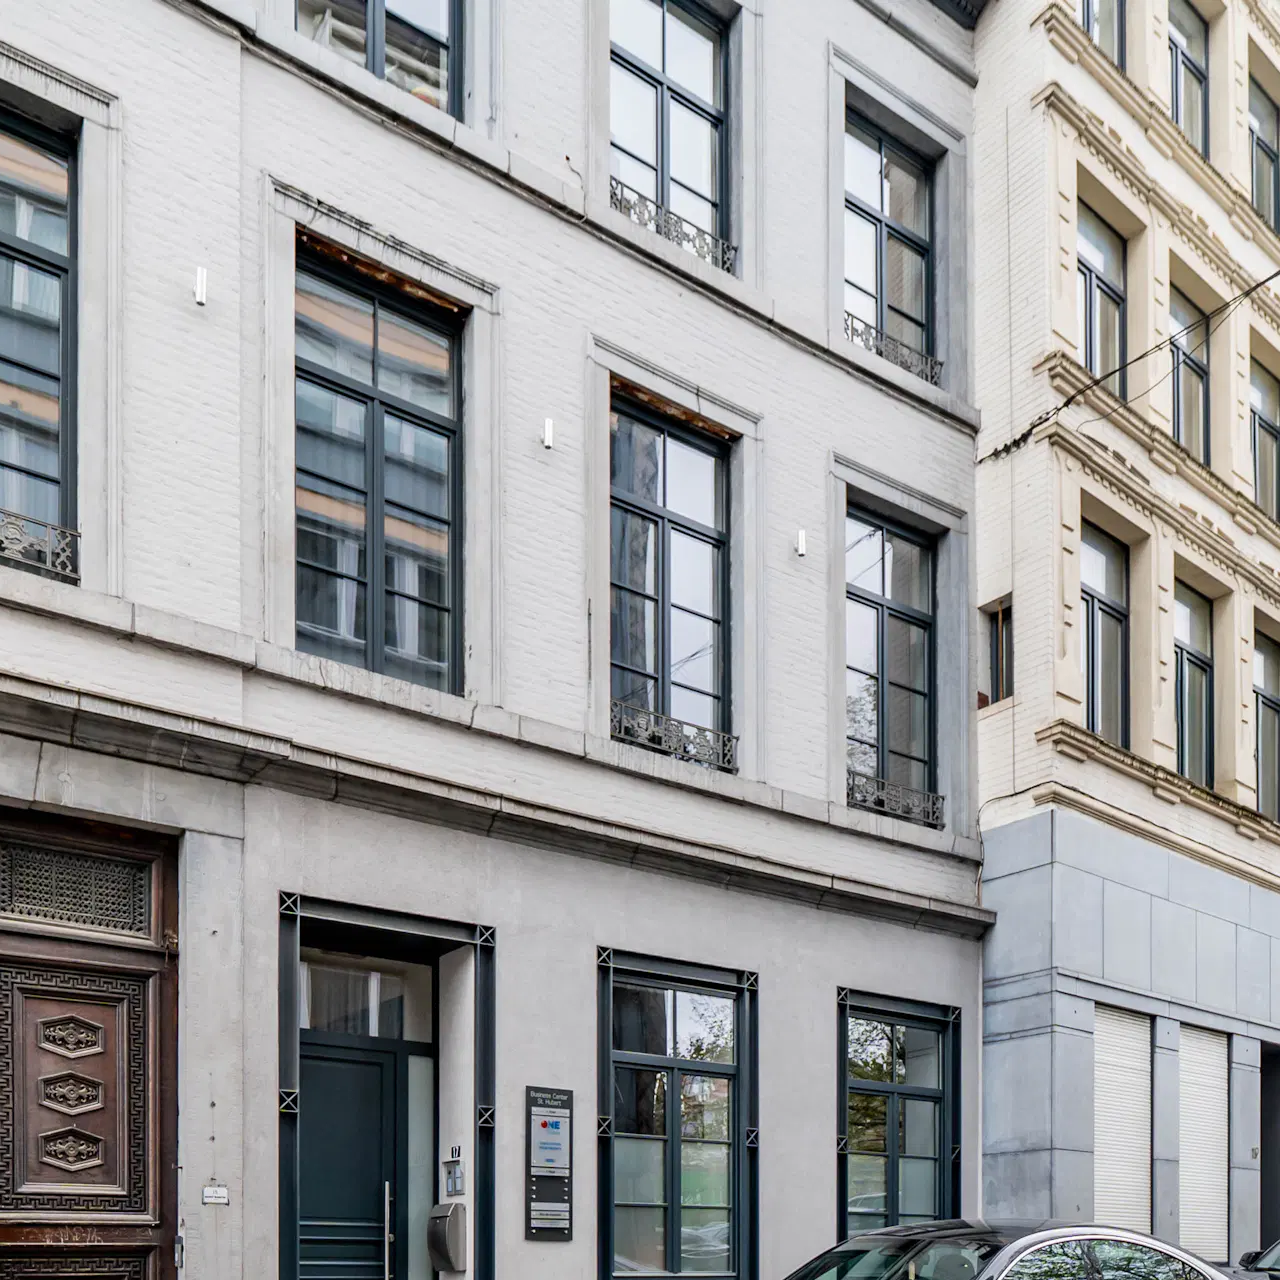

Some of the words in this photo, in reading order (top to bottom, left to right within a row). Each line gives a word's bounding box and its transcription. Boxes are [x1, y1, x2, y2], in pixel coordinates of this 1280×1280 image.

[530, 1091, 551, 1099] Business
[552, 1093, 568, 1101] Center
[452, 1146, 460, 1158] 17
